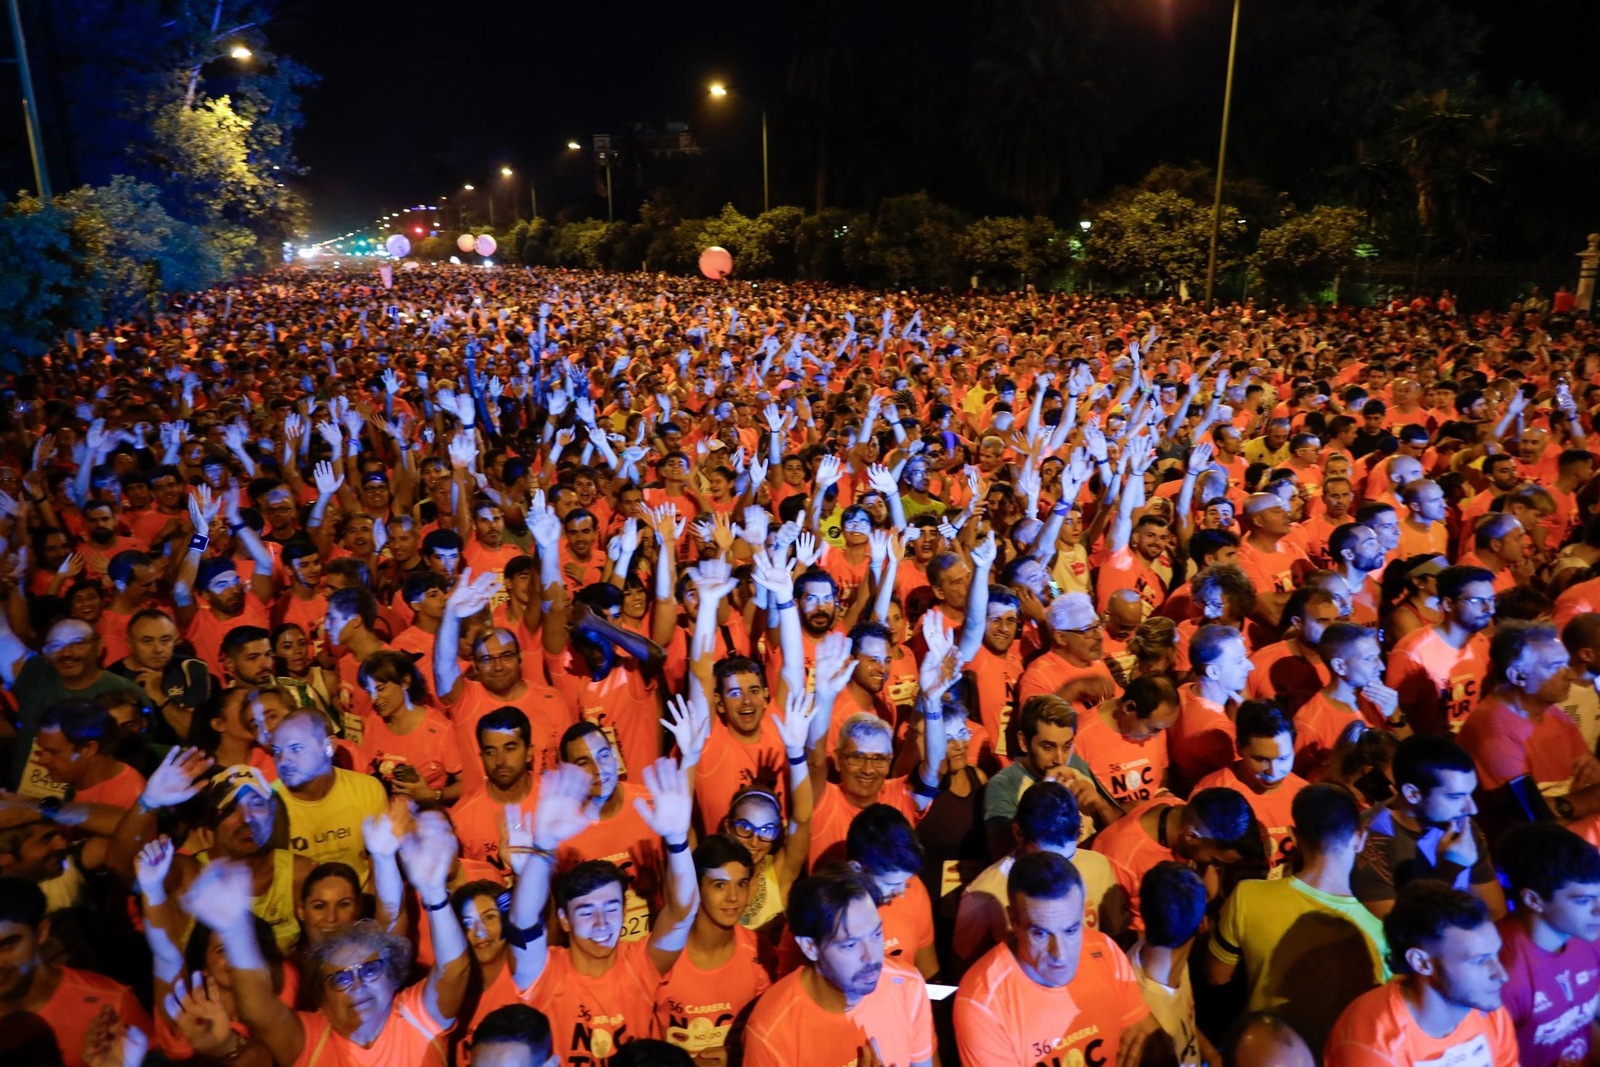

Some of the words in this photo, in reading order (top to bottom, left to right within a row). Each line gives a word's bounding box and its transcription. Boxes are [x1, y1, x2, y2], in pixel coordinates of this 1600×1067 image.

[667, 1000, 684, 1014] 36
[684, 1002, 732, 1014] CARRERA
[1032, 1039, 1052, 1058] 36
[1051, 1024, 1099, 1050] CARRERA
